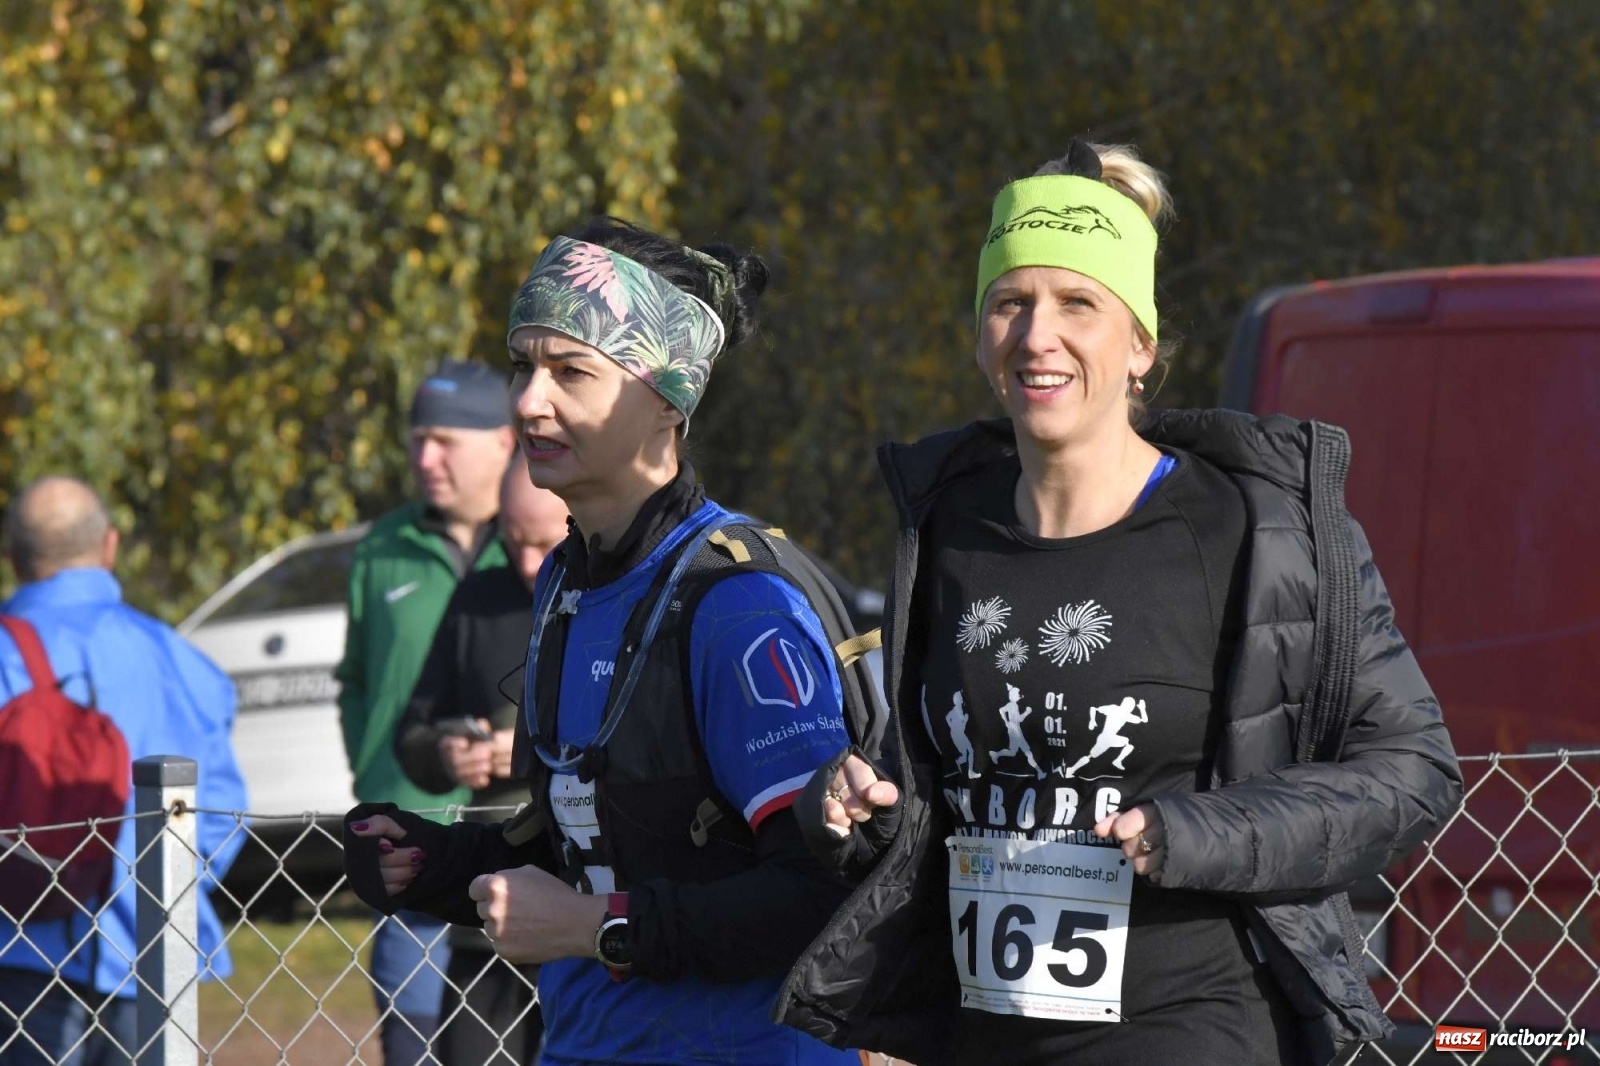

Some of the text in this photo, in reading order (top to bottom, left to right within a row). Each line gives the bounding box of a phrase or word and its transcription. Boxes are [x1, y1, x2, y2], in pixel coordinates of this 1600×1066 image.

[1045, 691, 1068, 711] 01.
[1044, 715, 1067, 734] 01.
[745, 721, 816, 755] Wodzisław
[1047, 737, 1066, 747] 2021
[999, 860, 1119, 883] www.personalbest.pl
[957, 900, 1110, 988] 165
